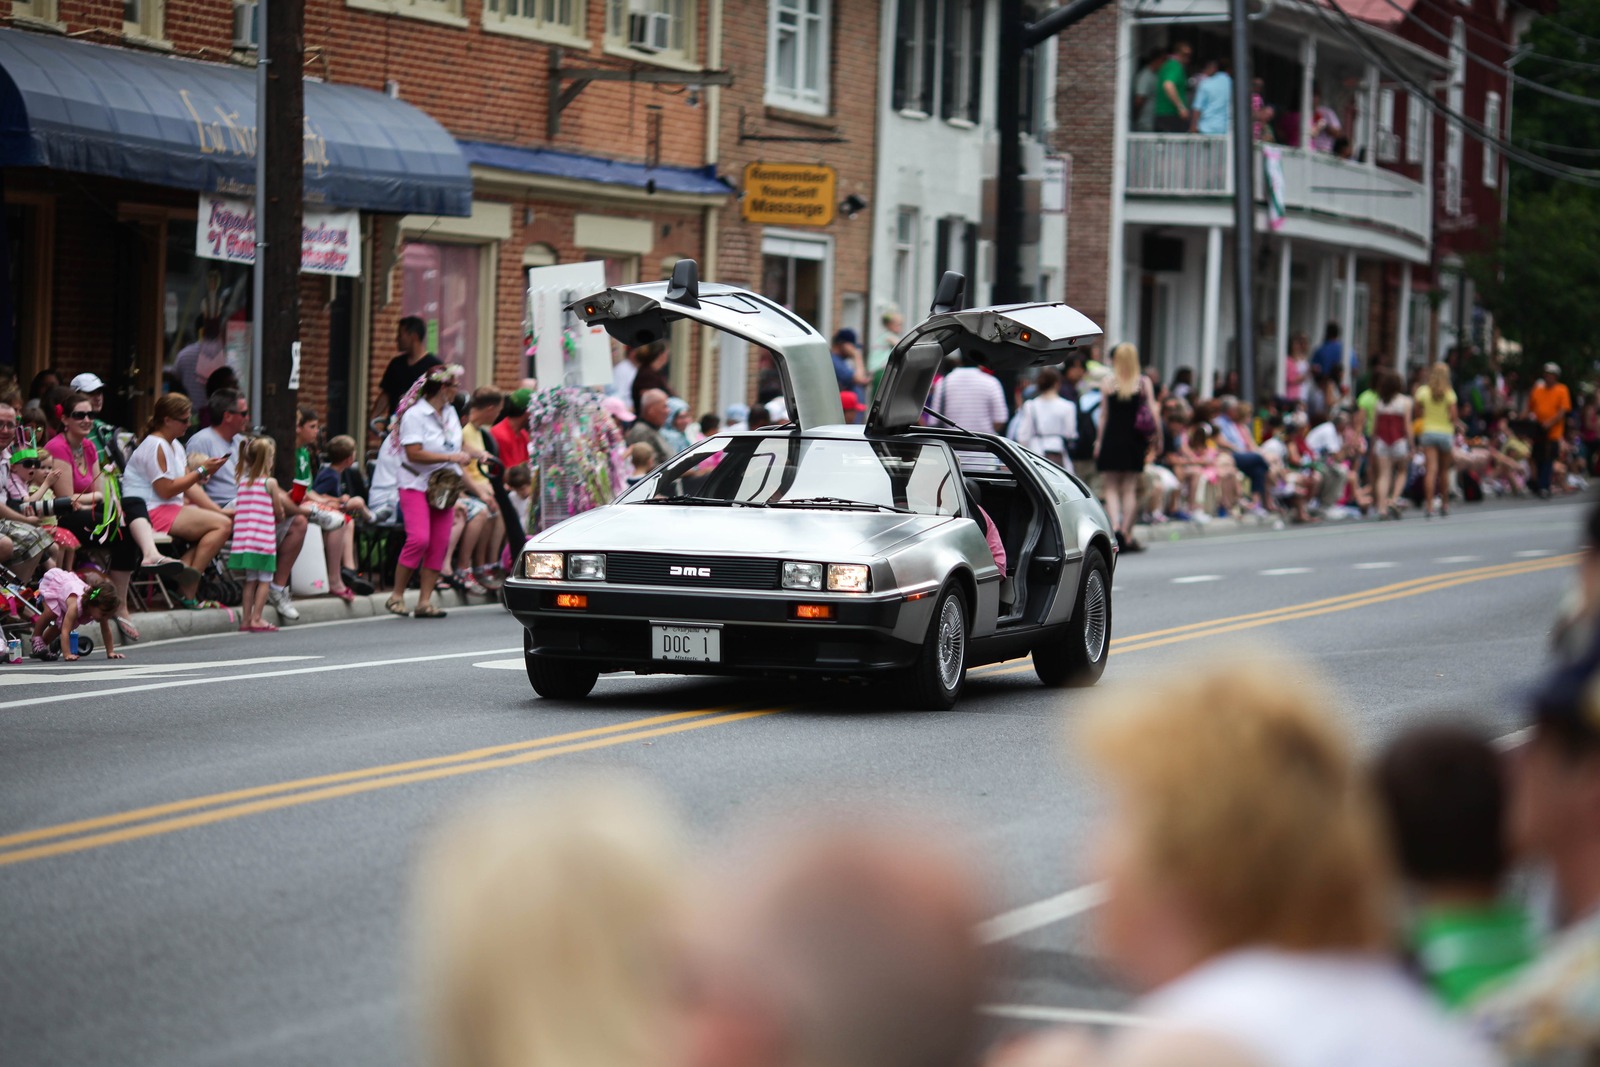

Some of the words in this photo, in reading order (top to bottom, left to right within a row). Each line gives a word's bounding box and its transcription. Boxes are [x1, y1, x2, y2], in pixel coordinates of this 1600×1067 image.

[751, 167, 828, 183] Remember
[751, 199, 825, 217] Massage
[664, 635, 690, 653] DOC
[703, 637, 708, 654] 1
